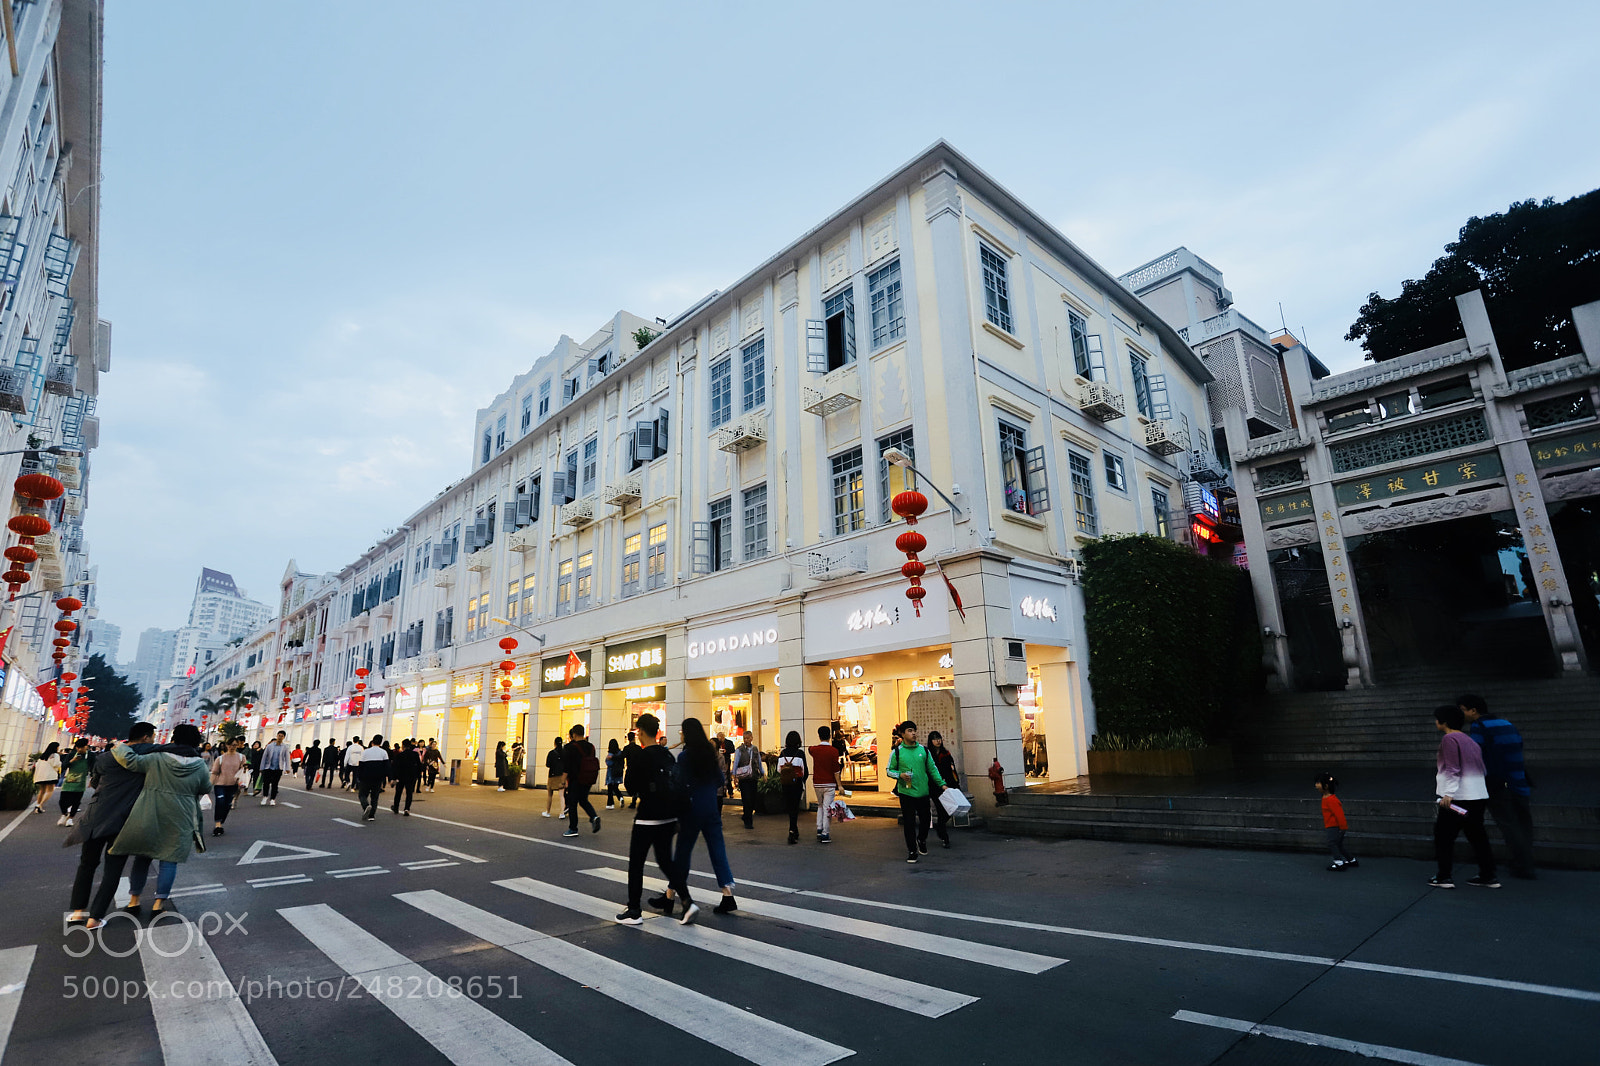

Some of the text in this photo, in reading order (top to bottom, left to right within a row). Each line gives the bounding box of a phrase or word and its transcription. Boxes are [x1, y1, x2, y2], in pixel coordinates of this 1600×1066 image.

[1355, 461, 1478, 500] 澤被甘棠
[688, 628, 778, 659] GIORDANO
